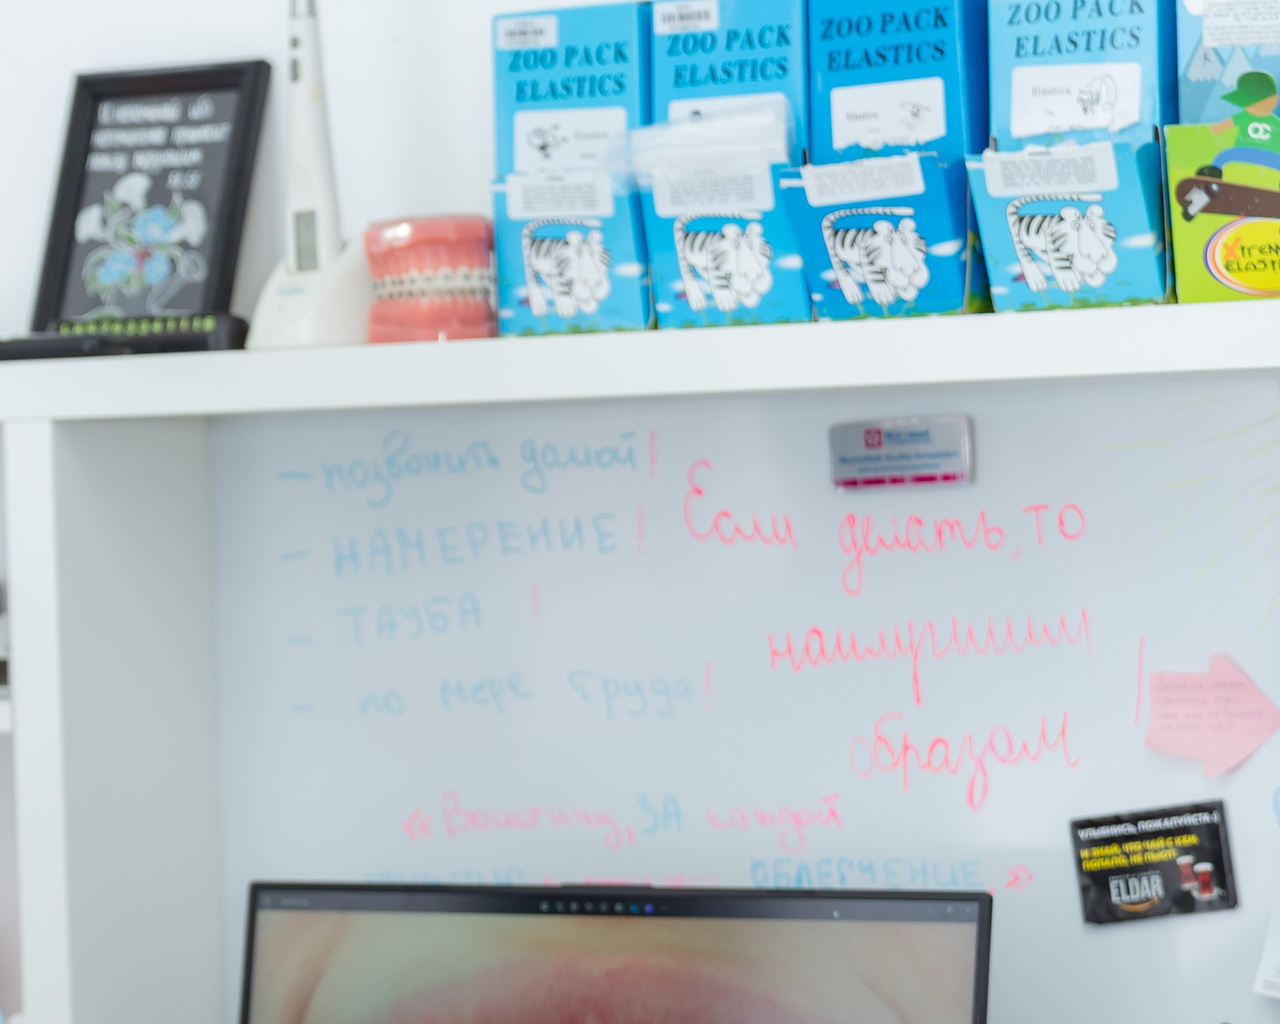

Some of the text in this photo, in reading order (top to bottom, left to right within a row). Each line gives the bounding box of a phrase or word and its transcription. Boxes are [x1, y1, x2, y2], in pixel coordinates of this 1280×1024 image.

[820, 5, 949, 41] ZOO PACK
[1007, 0, 1145, 27] ZOO PACK
[666, 23, 792, 57] ZOO PACK
[826, 40, 947, 72] ELASTICS
[1013, 26, 1142, 60] ELASTICS
[508, 41, 629, 73] ZOO PACK
[673, 56, 789, 88] ELASTICS
[515, 73, 626, 102] ELASTICS
[1110, 874, 1165, 905] ELDAR
